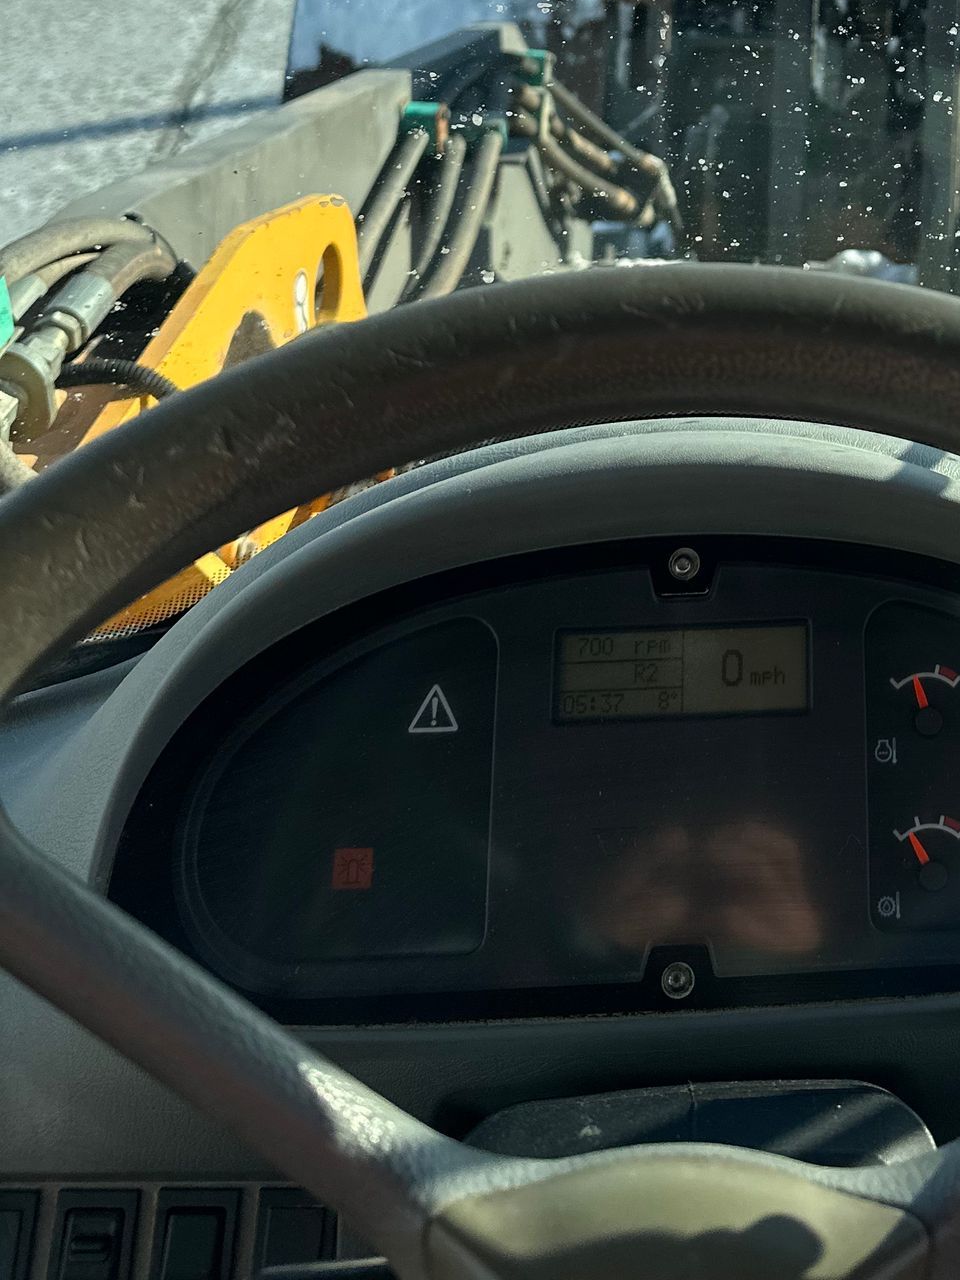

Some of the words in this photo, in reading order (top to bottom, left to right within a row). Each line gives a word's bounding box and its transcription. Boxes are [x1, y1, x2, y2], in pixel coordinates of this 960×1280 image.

[578, 636, 614, 657] 700
[634, 637, 671, 656] rpm
[634, 663, 658, 684] R2
[721, 649, 744, 687] 0
[750, 665, 786, 686] mph
[562, 692, 625, 715] 05:37
